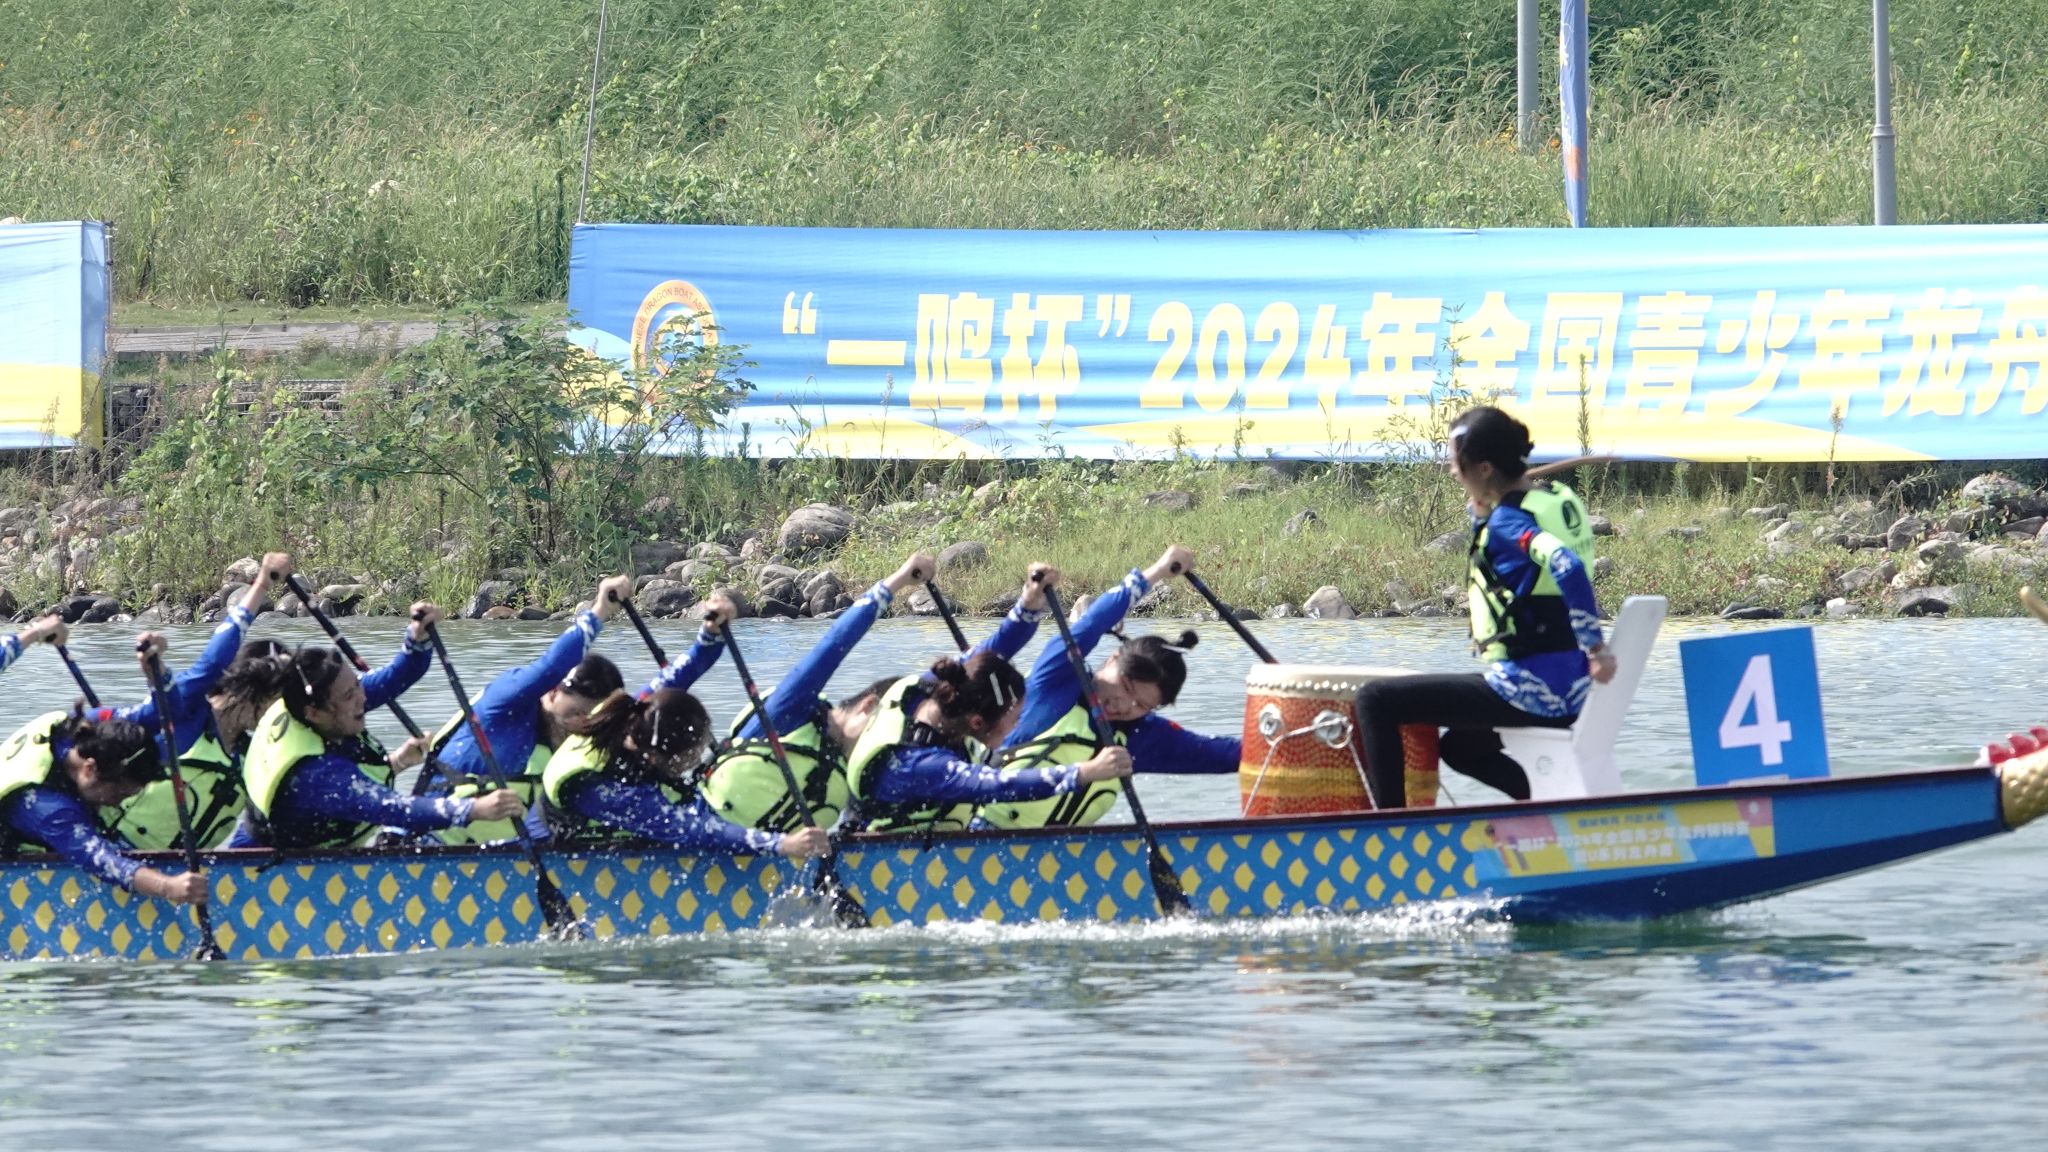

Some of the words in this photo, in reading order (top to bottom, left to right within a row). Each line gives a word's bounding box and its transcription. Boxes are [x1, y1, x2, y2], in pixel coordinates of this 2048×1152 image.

[644, 287, 673, 315] DRAGON
[673, 286, 694, 302] BOAT
[1719, 654, 1792, 766] 4
